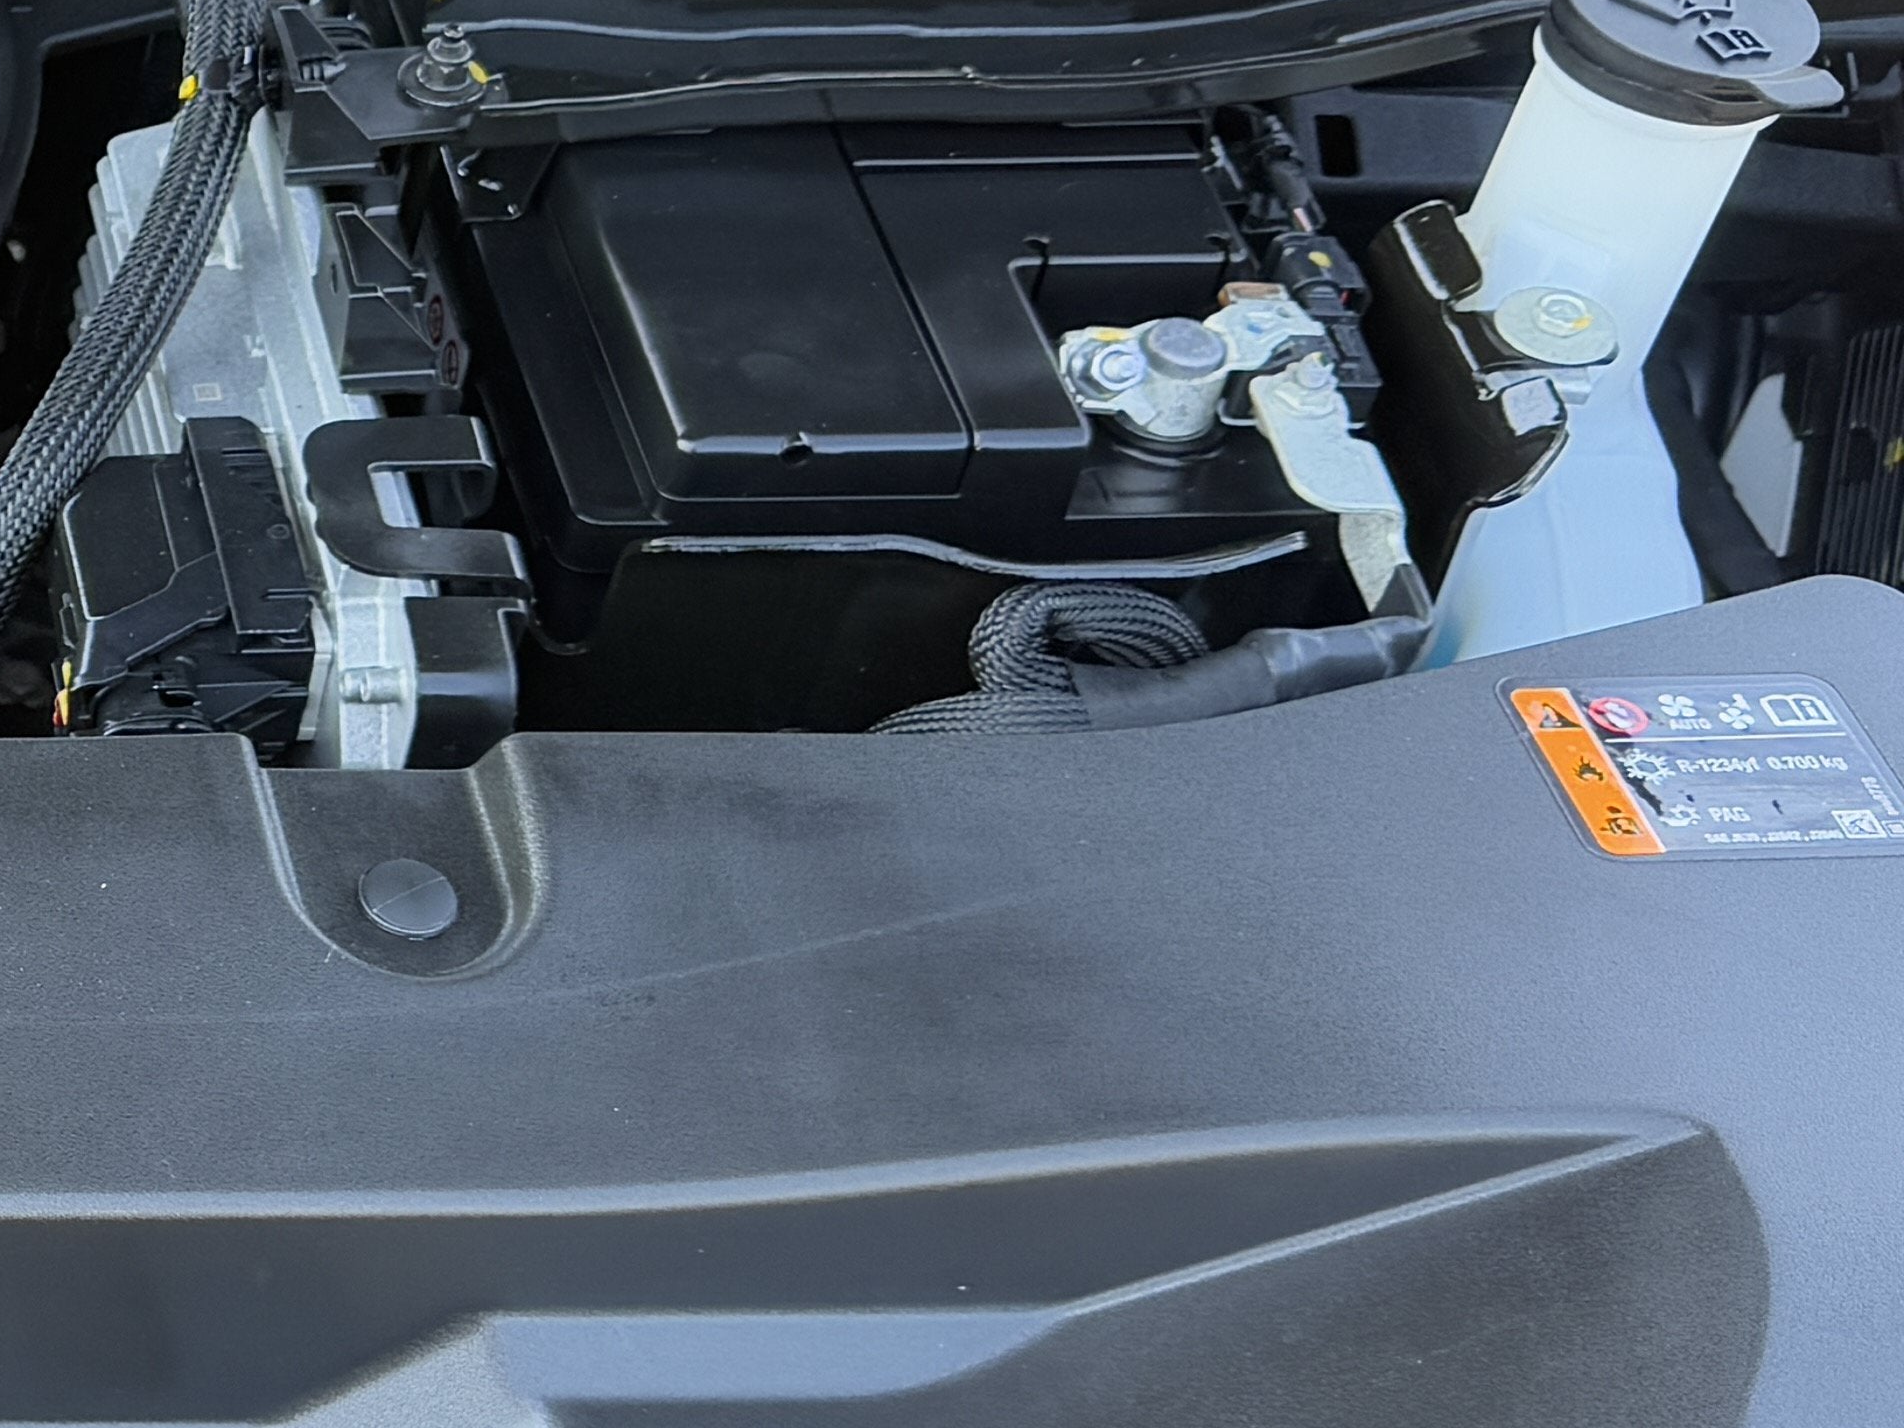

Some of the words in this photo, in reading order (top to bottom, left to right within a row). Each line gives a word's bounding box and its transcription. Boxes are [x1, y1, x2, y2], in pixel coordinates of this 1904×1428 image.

[1669, 718, 1712, 731] AUTO
[1765, 755, 1820, 771] 0.700
[1819, 754, 1849, 771] kg
[1707, 806, 1751, 823] PAG
